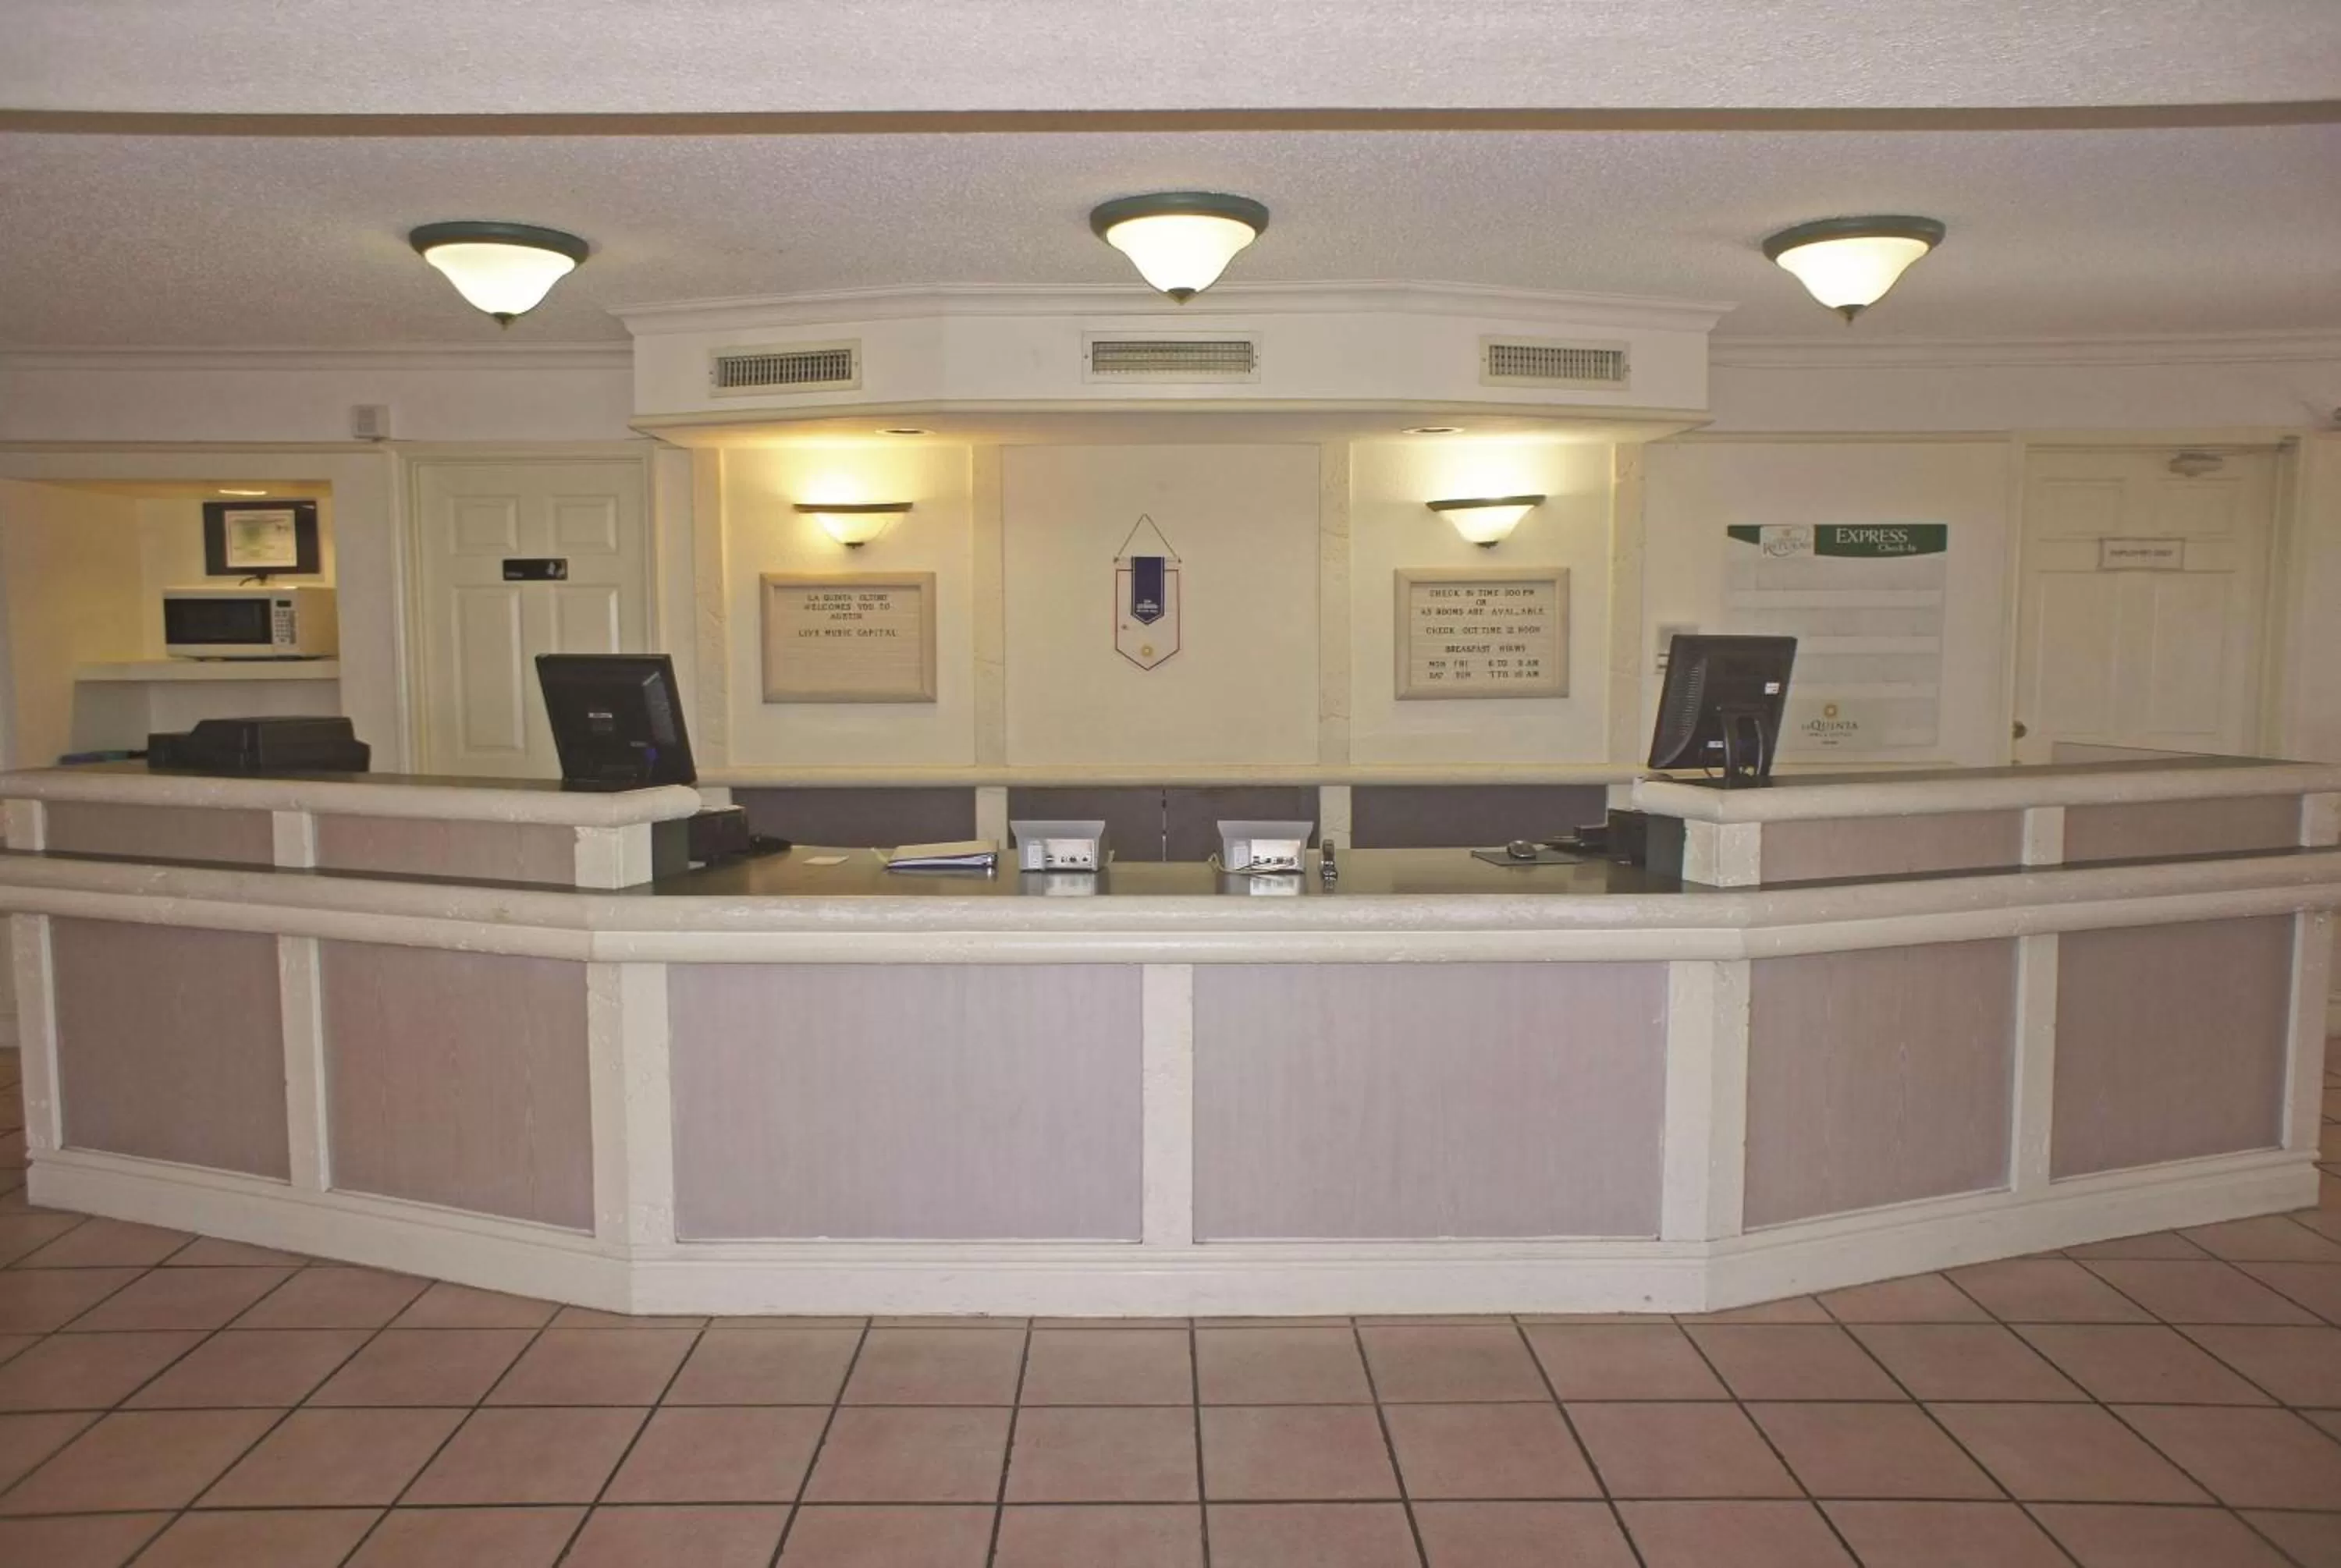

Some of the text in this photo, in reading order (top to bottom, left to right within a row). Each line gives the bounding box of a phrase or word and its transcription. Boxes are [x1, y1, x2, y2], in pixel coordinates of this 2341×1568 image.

[1836, 528, 1909, 544] EXPRESS
[798, 629, 897, 637] LIVE MUSIC CAPITAL
